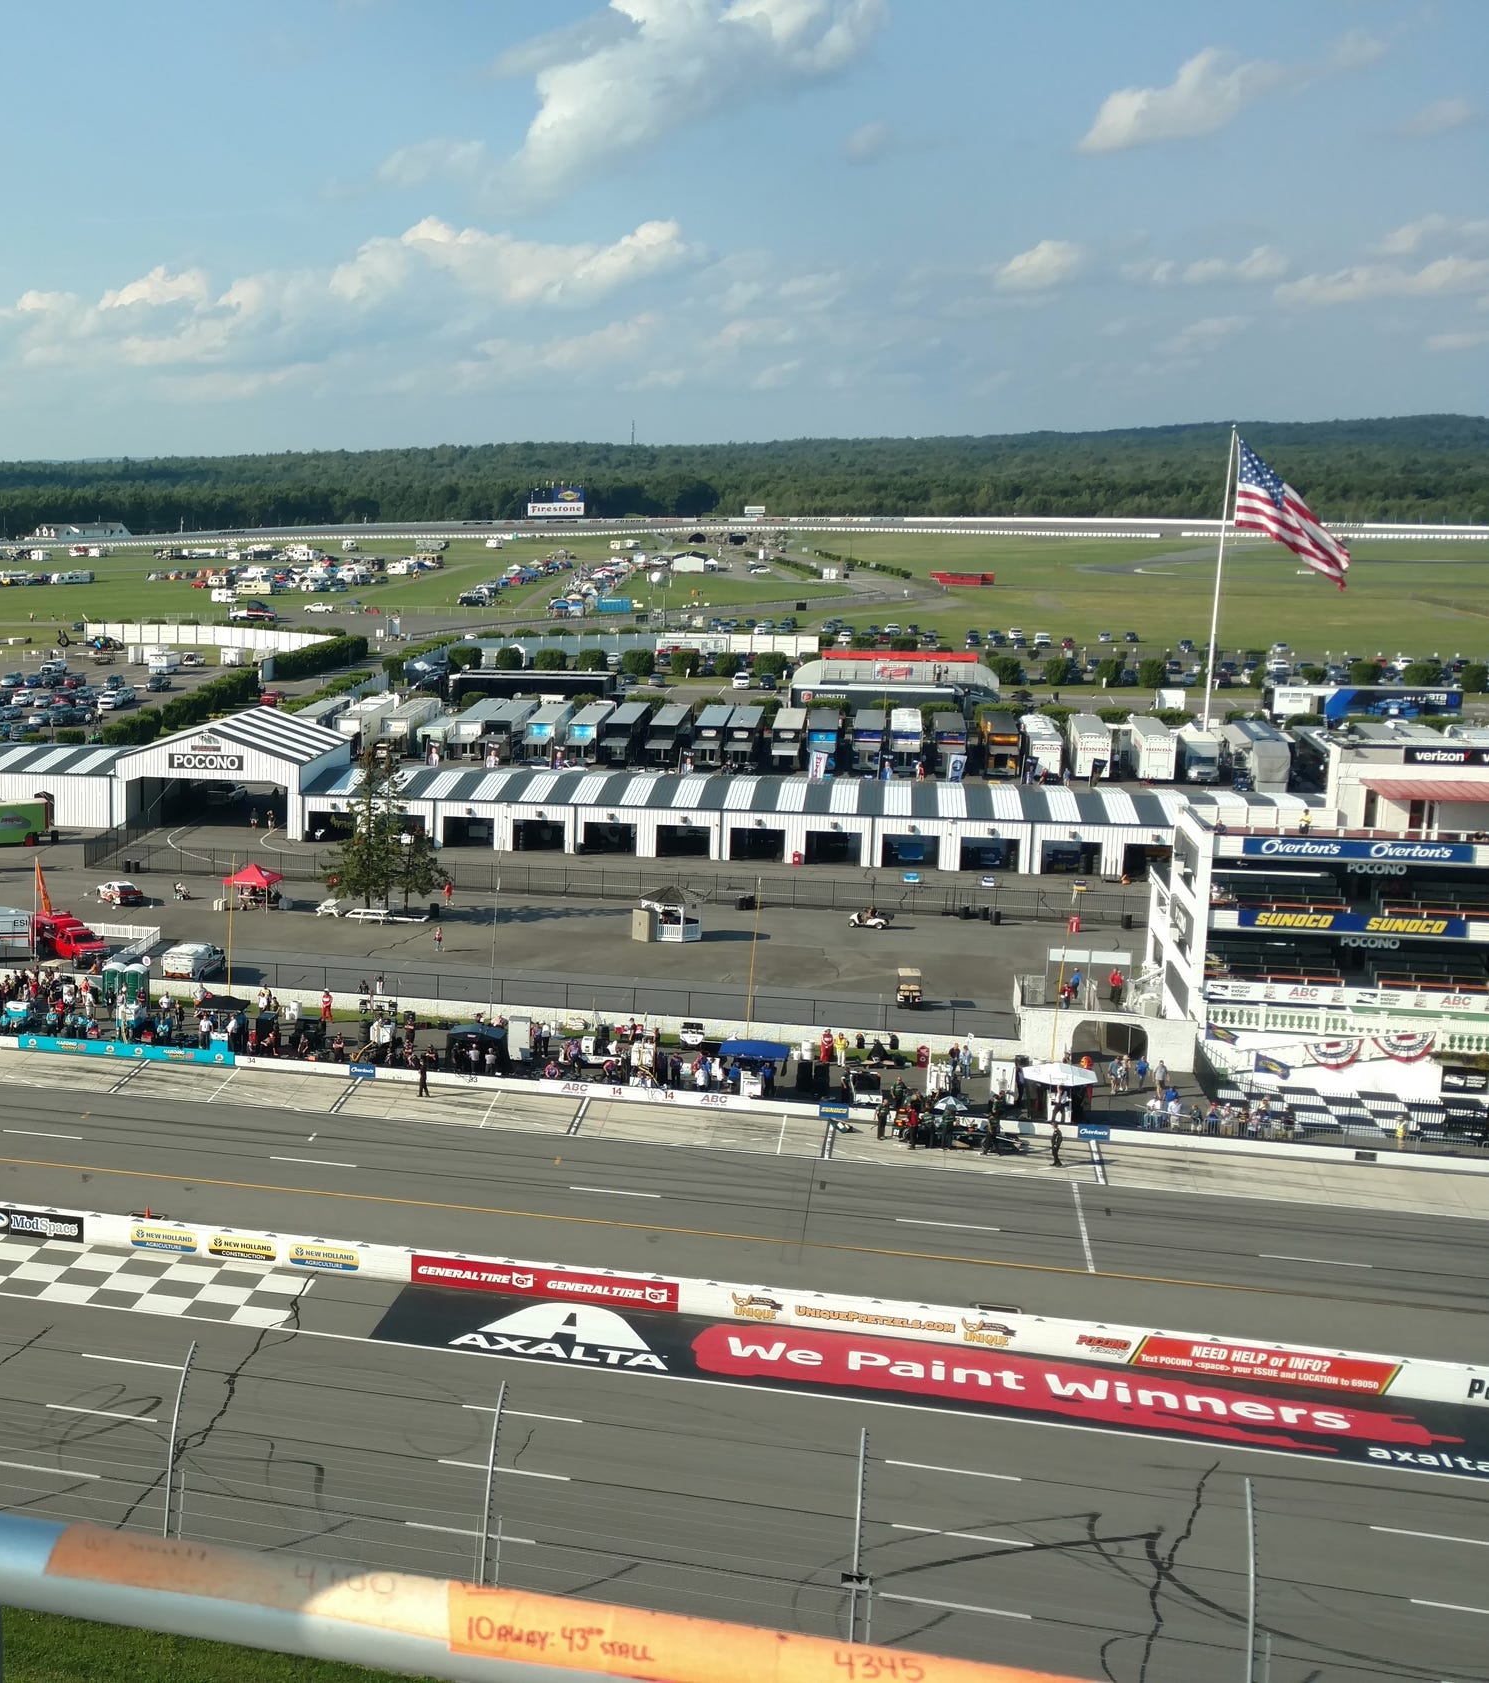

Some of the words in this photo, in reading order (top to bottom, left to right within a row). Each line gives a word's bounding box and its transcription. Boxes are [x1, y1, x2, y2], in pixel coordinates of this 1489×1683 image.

[530, 505, 582, 513] Firestone
[173, 754, 239, 770] POCONO
[1415, 750, 1465, 763] verizon
[1261, 839, 1342, 856] Overton's
[1369, 842, 1453, 859] Overton's
[1347, 863, 1407, 876] POCONO
[13, 919, 28, 927] ESI
[1254, 912, 1335, 928] SUNOCO
[1366, 917, 1448, 934] SUNOCO
[1340, 937, 1400, 950] POCONO
[1289, 986, 1319, 998] ABC
[1440, 995, 1471, 1006] ABC
[561, 1082, 589, 1093] ABC
[611, 1087, 622, 1096] 14
[664, 1091, 674, 1099] 14
[700, 1094, 728, 1104] ABC
[820, 1106, 848, 1115] SUNOCO
[11, 1214, 78, 1237] ModSpace
[146, 1231, 160, 1239] NEW
[162, 1233, 192, 1243] HOLLAND
[145, 1241, 182, 1251] AGRICULTURE
[223, 1240, 239, 1248] NEW
[240, 1242, 272, 1252] HOLLAND
[221, 1250, 266, 1261] CONSTRUCTION
[305, 1249, 321, 1257] NEW
[322, 1251, 355, 1261] HOLLAND
[304, 1259, 343, 1270] AGRICULTURE
[417, 1265, 479, 1282] GENERAL
[478, 1273, 511, 1284] TIRE
[547, 1280, 612, 1297] GENERAL
[610, 1288, 644, 1299] TIRE
[733, 1305, 777, 1321] UNIQUE
[963, 1331, 1010, 1347] UNIQUE
[1076, 1334, 1132, 1352] POCONO
[448, 1333, 668, 1371] AXALTA
[1191, 1345, 1229, 1361] NEED
[1231, 1349, 1267, 1366] HELP
[1269, 1354, 1285, 1368] or
[1288, 1356, 1332, 1373] INFO?
[1140, 1353, 1158, 1364] Text
[1159, 1356, 1193, 1368] POCONO
[1194, 1360, 1230, 1373] <space>
[1232, 1366, 1252, 1376] your
[1253, 1366, 1279, 1378] ISSUE
[1280, 1370, 1297, 1380] and
[1298, 1373, 1339, 1386] LOCATION
[1340, 1377, 1350, 1387] to
[1351, 1378, 1379, 1390] 69050
[727, 1336, 823, 1366] We
[847, 1350, 1026, 1391] Paint
[1044, 1373, 1351, 1430] Winners
[1367, 1446, 1489, 1473] axalta
[467, 1616, 496, 1642] 10
[600, 1640, 655, 1663] STALL
[833, 1650, 926, 1682] 4345
